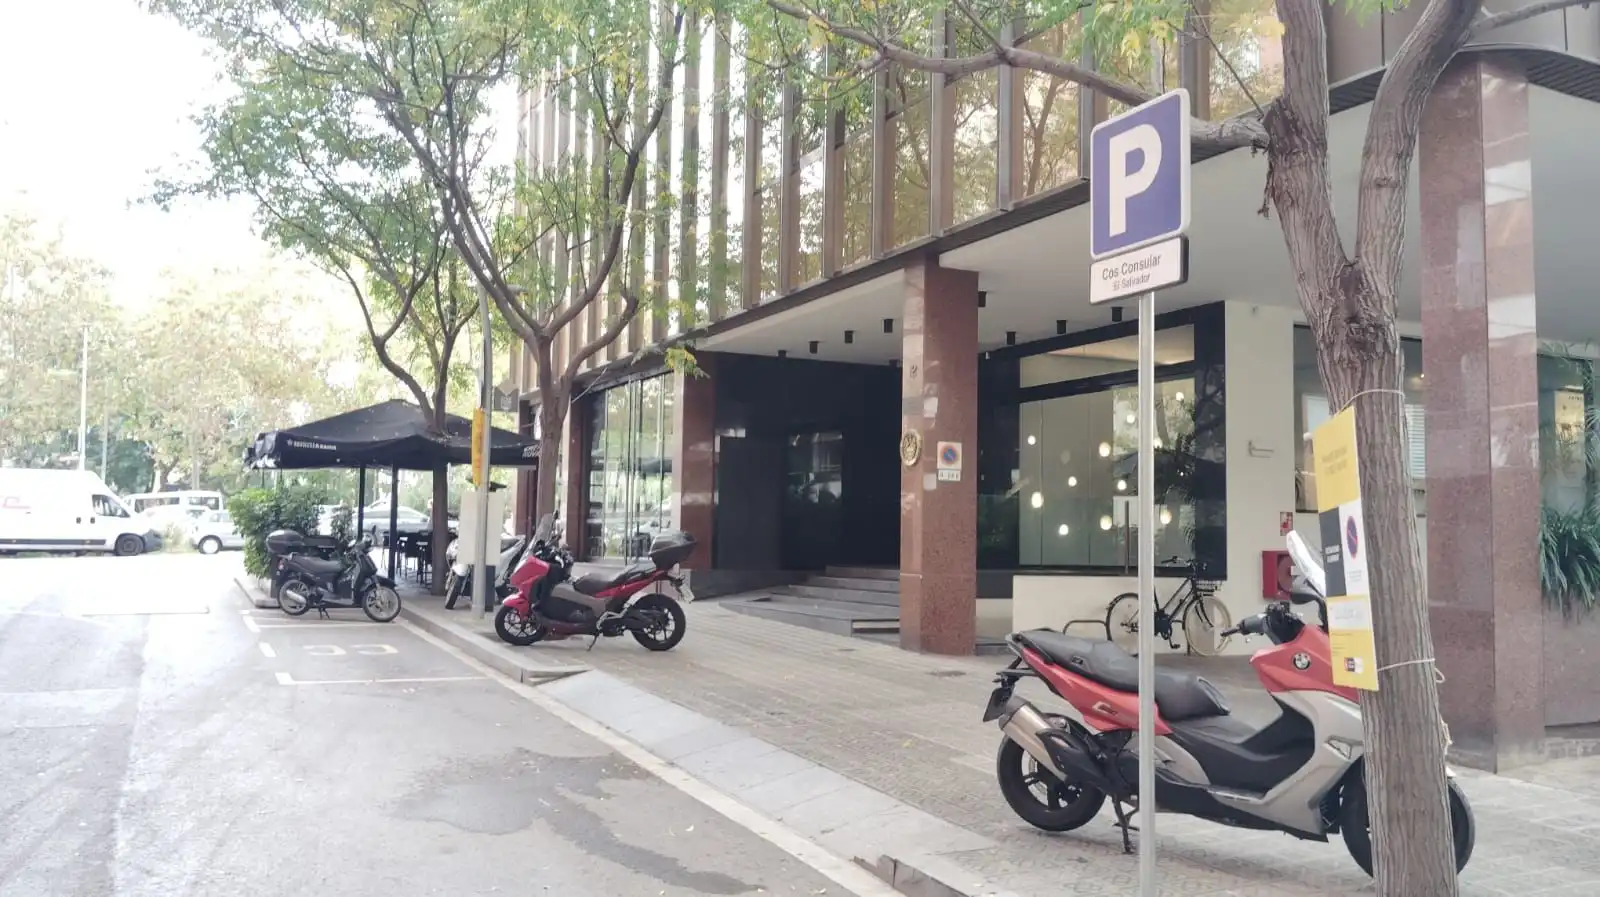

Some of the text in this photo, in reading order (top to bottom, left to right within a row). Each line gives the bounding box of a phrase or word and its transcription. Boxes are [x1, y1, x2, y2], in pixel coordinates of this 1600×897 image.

[1109, 124, 1162, 237] P
[1102, 254, 1161, 280] Cos Consular
[1121, 273, 1150, 288] Salvador
